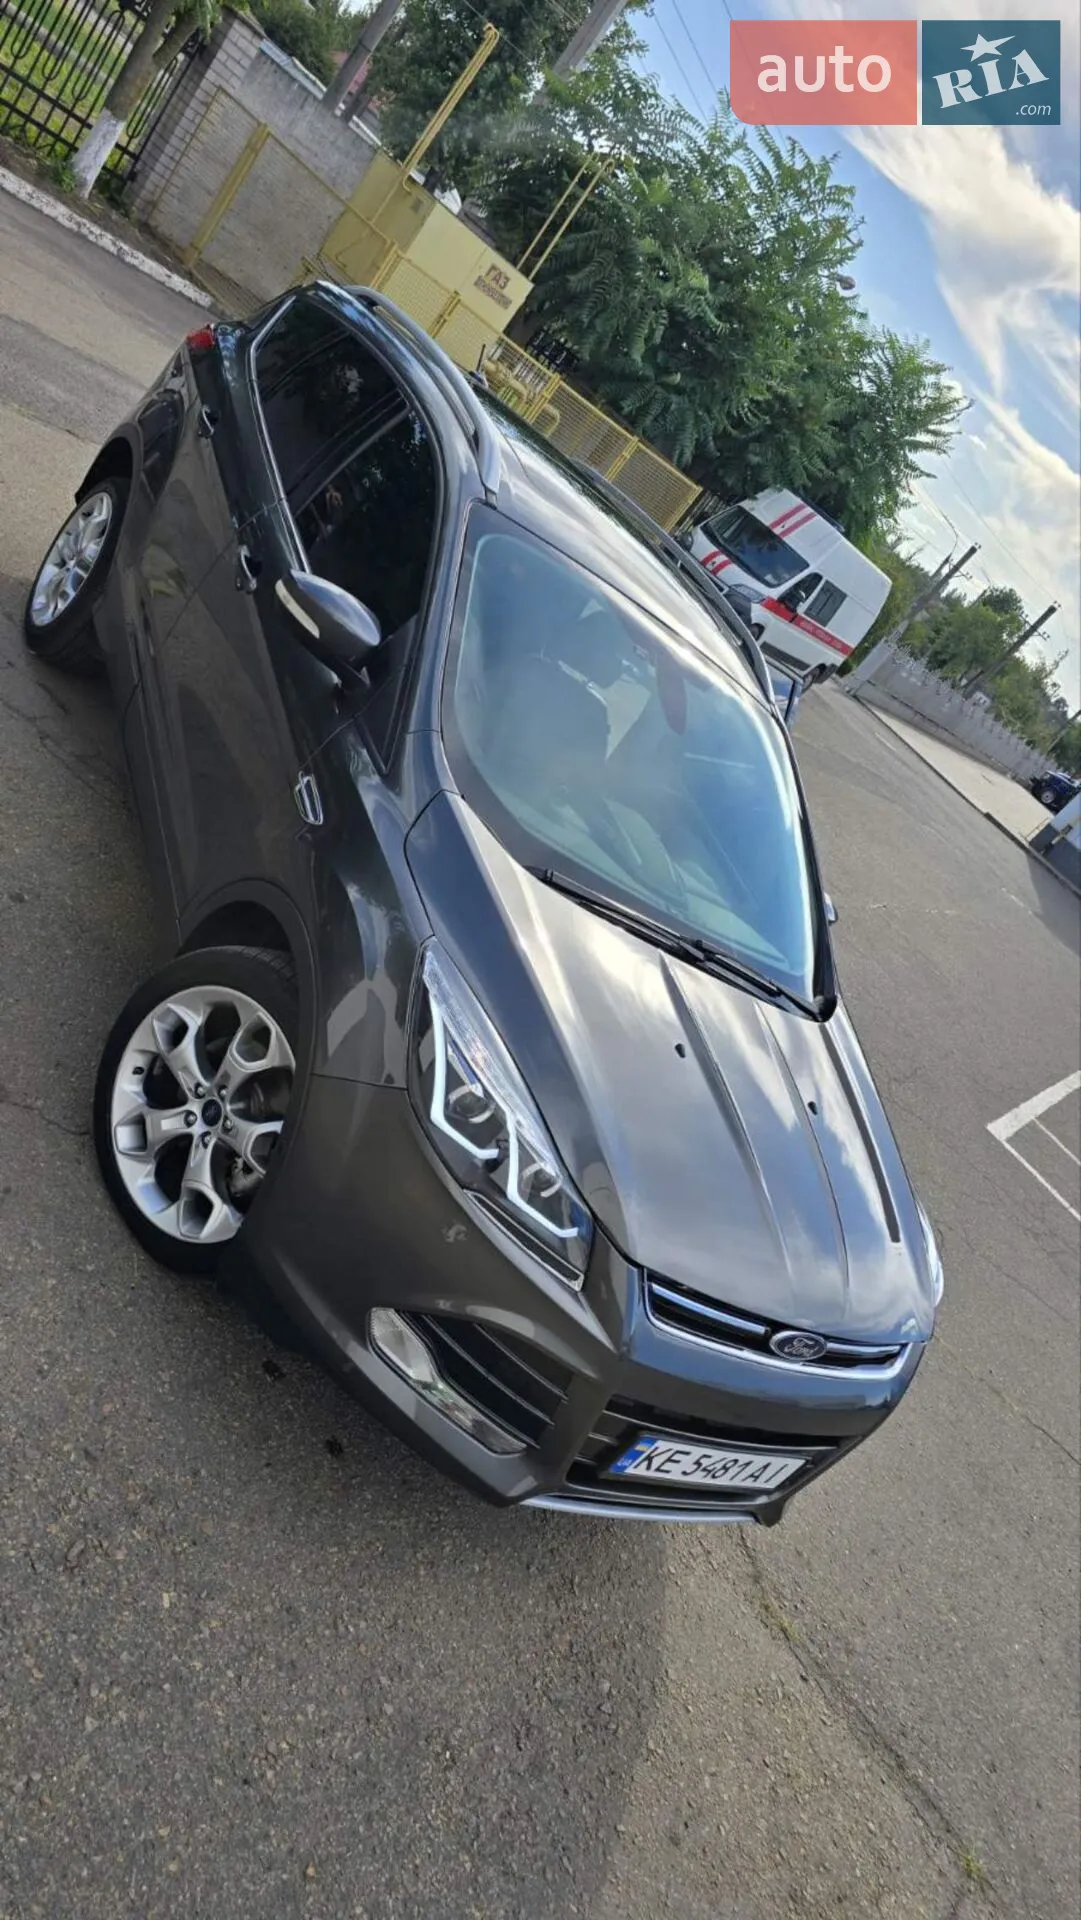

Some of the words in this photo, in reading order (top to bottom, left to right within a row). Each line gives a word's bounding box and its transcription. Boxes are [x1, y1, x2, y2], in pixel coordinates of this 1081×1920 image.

[485, 264, 511, 290] ГАЗ
[784, 1337, 819, 1358] Ford
[633, 1446, 690, 1474] KE
[681, 1454, 753, 1482] 5481
